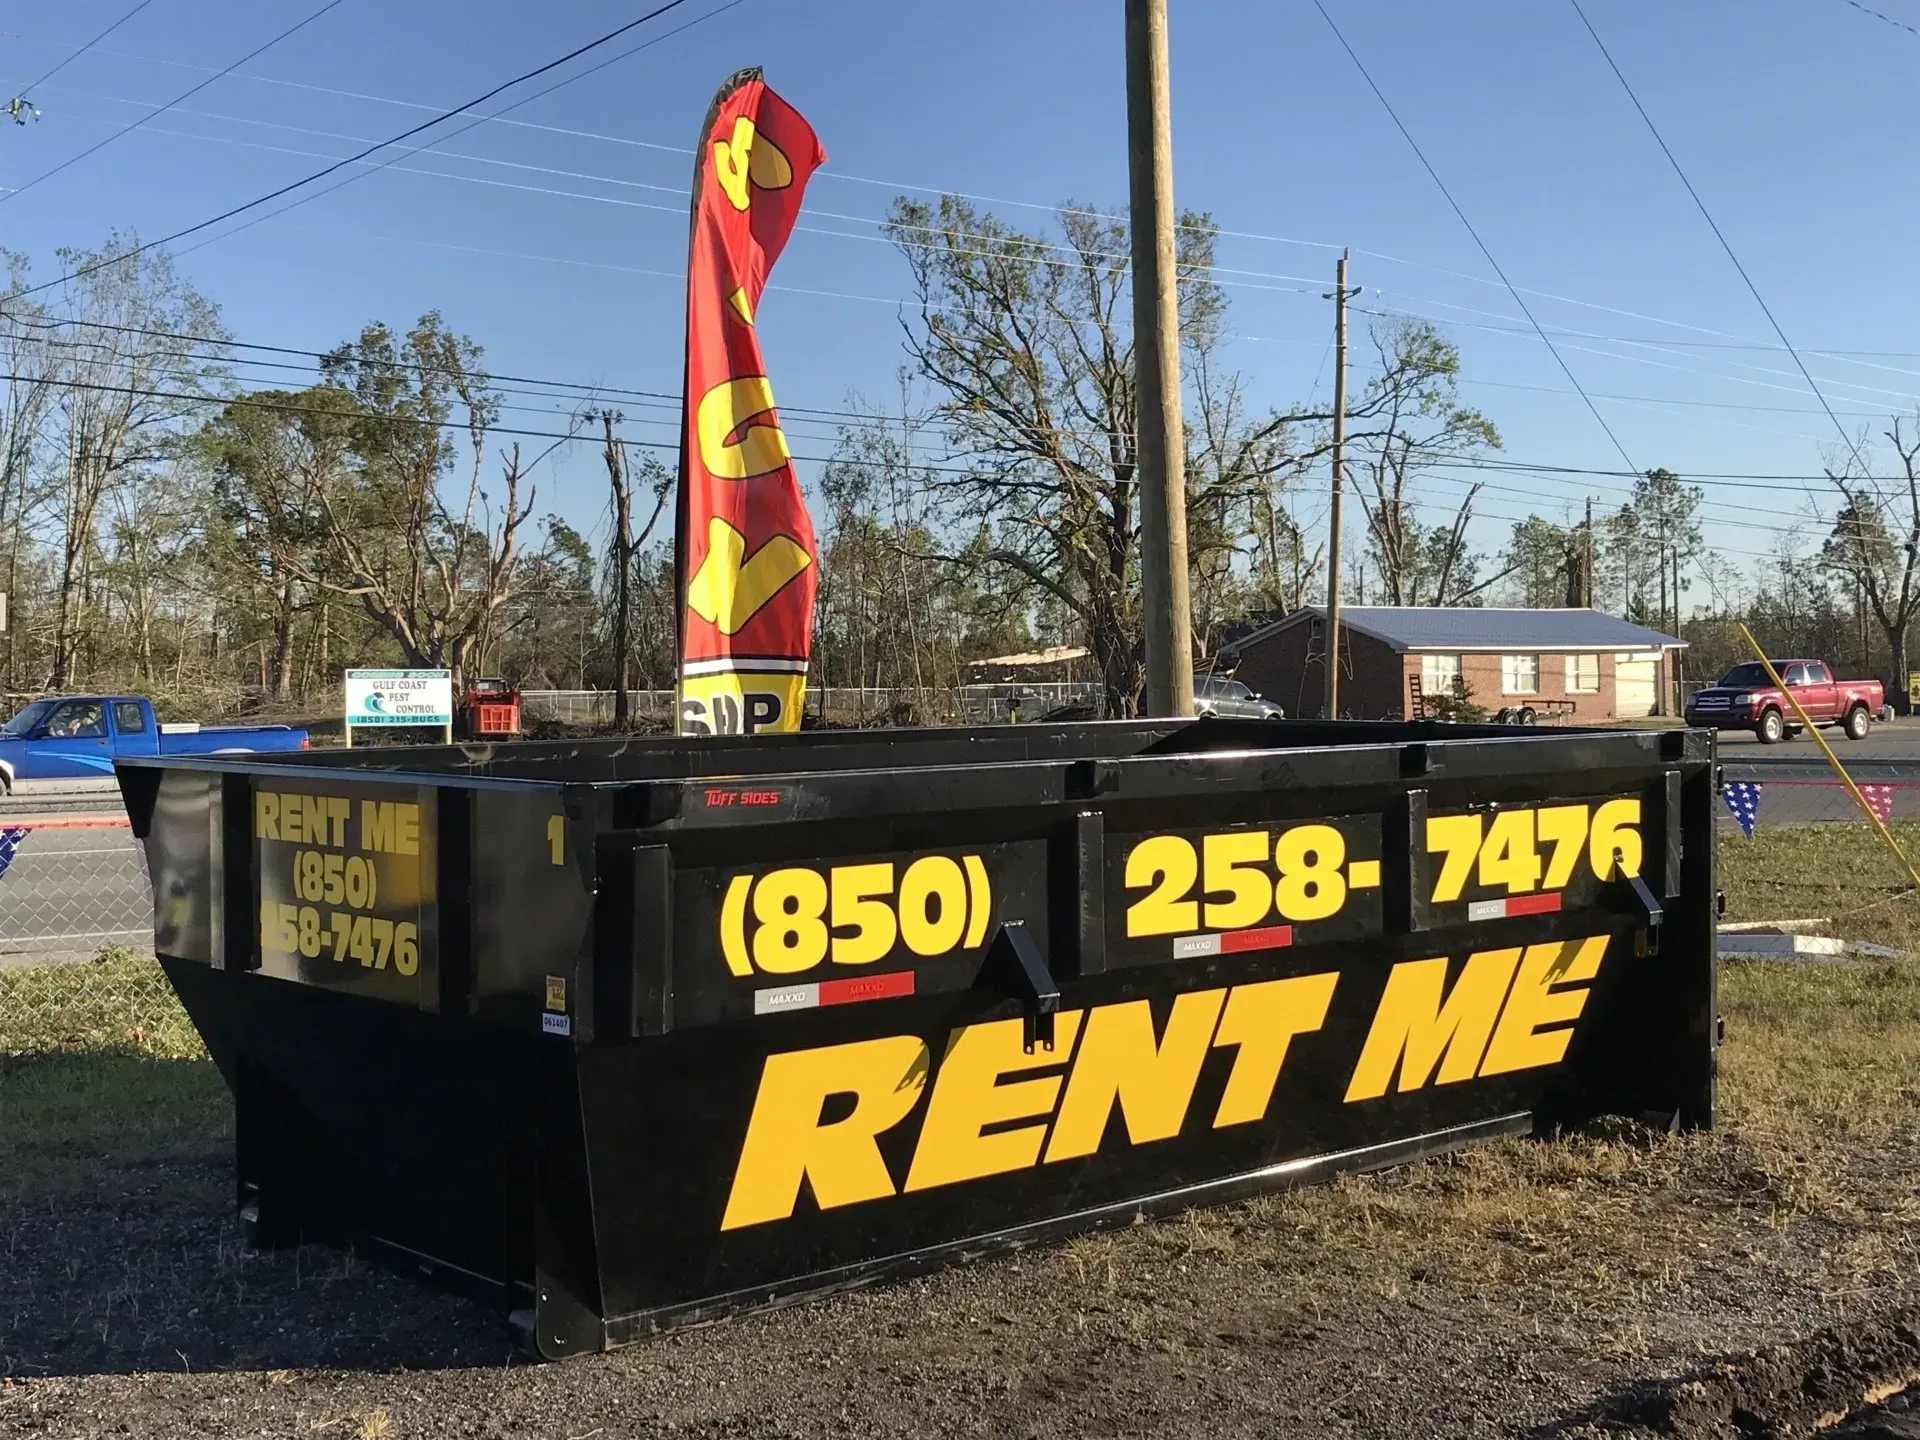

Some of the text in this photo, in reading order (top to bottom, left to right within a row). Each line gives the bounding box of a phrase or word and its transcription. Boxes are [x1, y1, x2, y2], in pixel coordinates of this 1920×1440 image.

[373, 680, 427, 689] GULF COAST
[389, 692, 410, 701] PEST
[357, 714, 384, 723] (850)
[396, 704, 436, 713] CONTROL
[704, 788, 781, 806] TUFF SIDES
[255, 791, 420, 856] RENT ME
[547, 814, 565, 866] 1
[293, 850, 377, 909] (850)
[719, 799, 1642, 977] (850) 258- 7476
[719, 935, 1611, 1232] RENT ME
